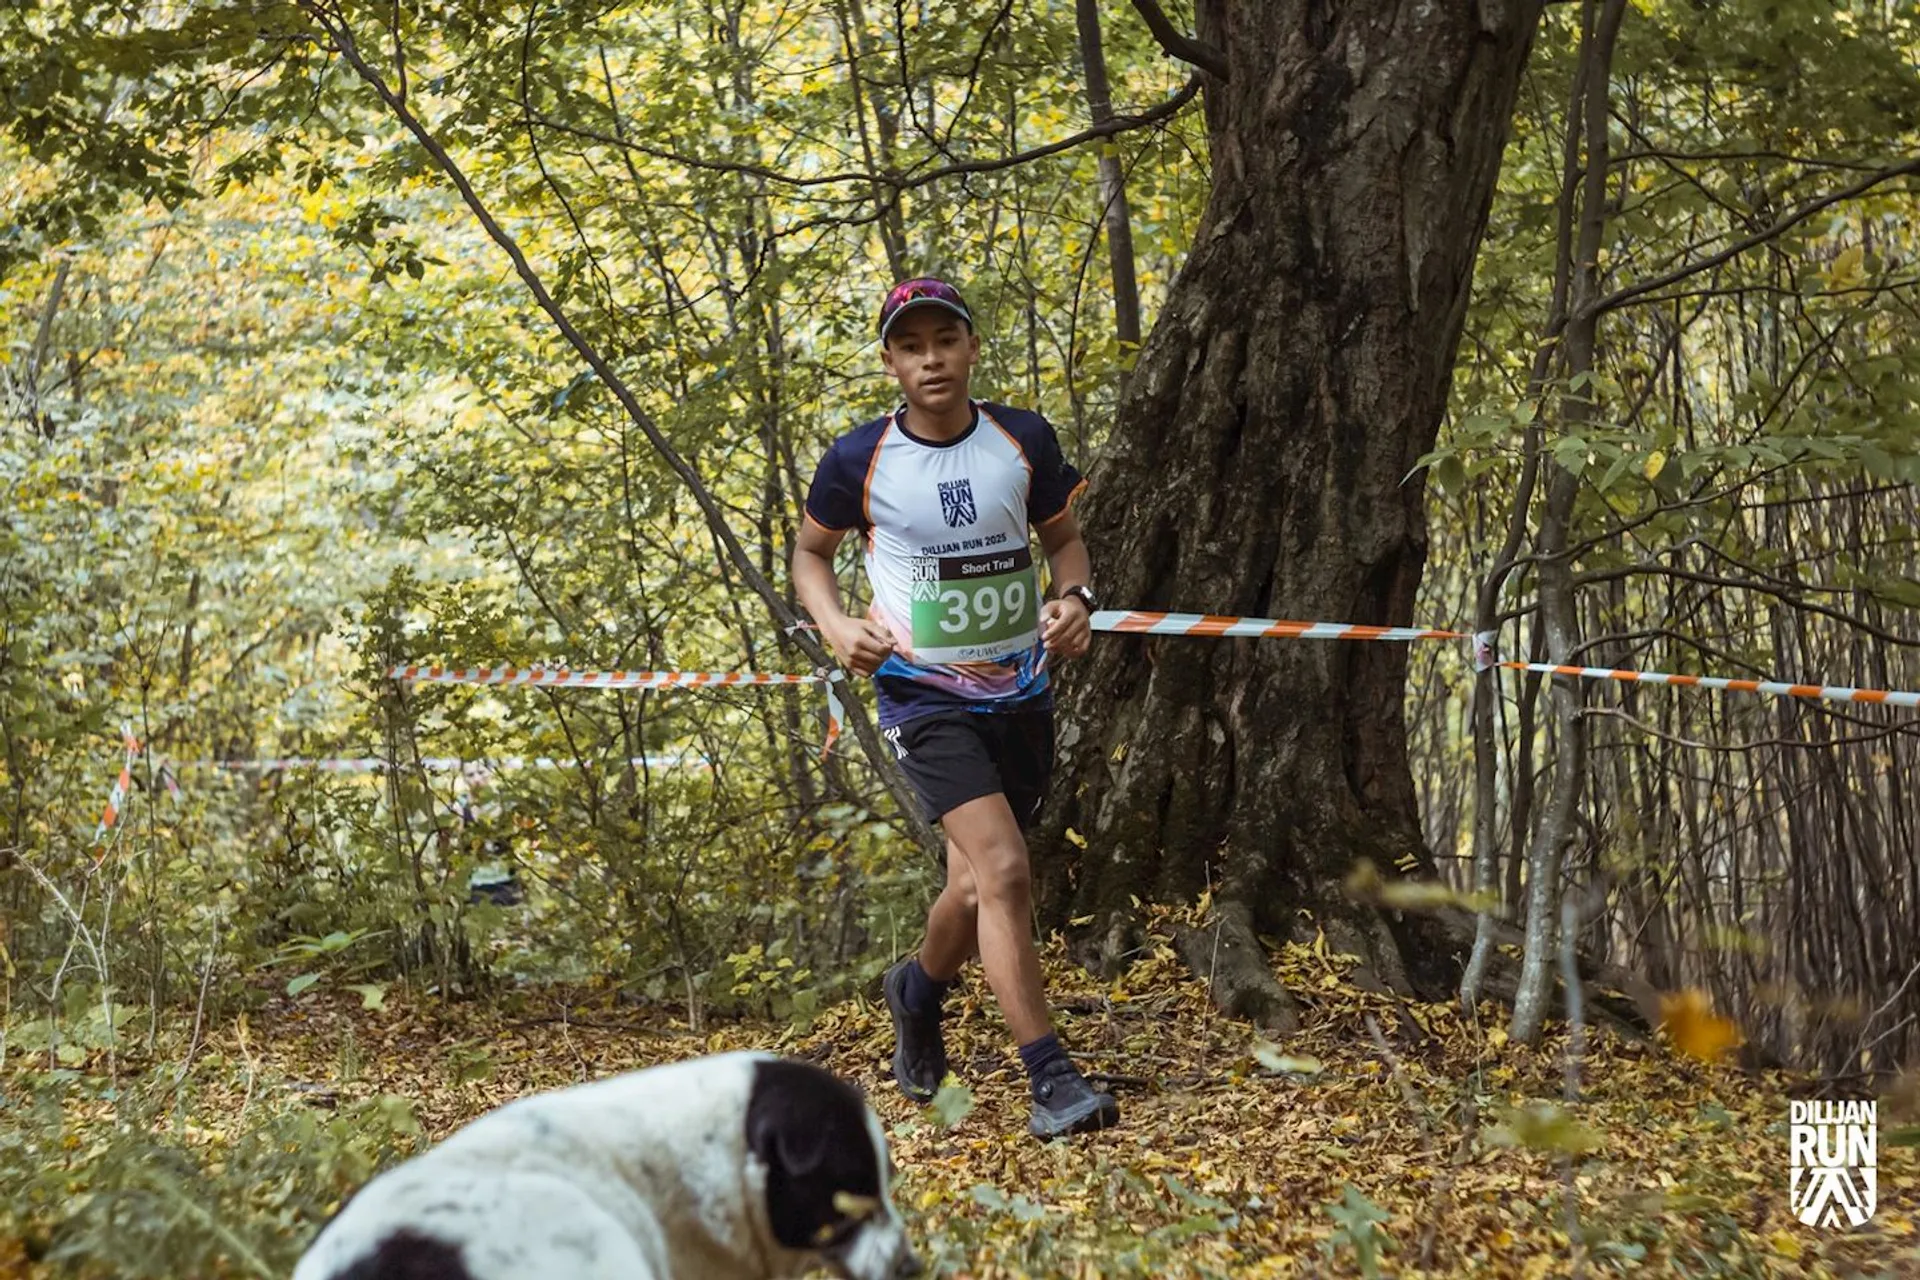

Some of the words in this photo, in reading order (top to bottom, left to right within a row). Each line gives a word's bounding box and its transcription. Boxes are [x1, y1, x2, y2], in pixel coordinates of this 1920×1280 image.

[940, 487, 974, 507] RUN
[962, 538, 983, 550] RUN
[985, 532, 1007, 546] 2025
[911, 566, 939, 581] RUN
[961, 562, 990, 574] Short
[993, 557, 1015, 571] Trail
[939, 581, 1026, 633] 399
